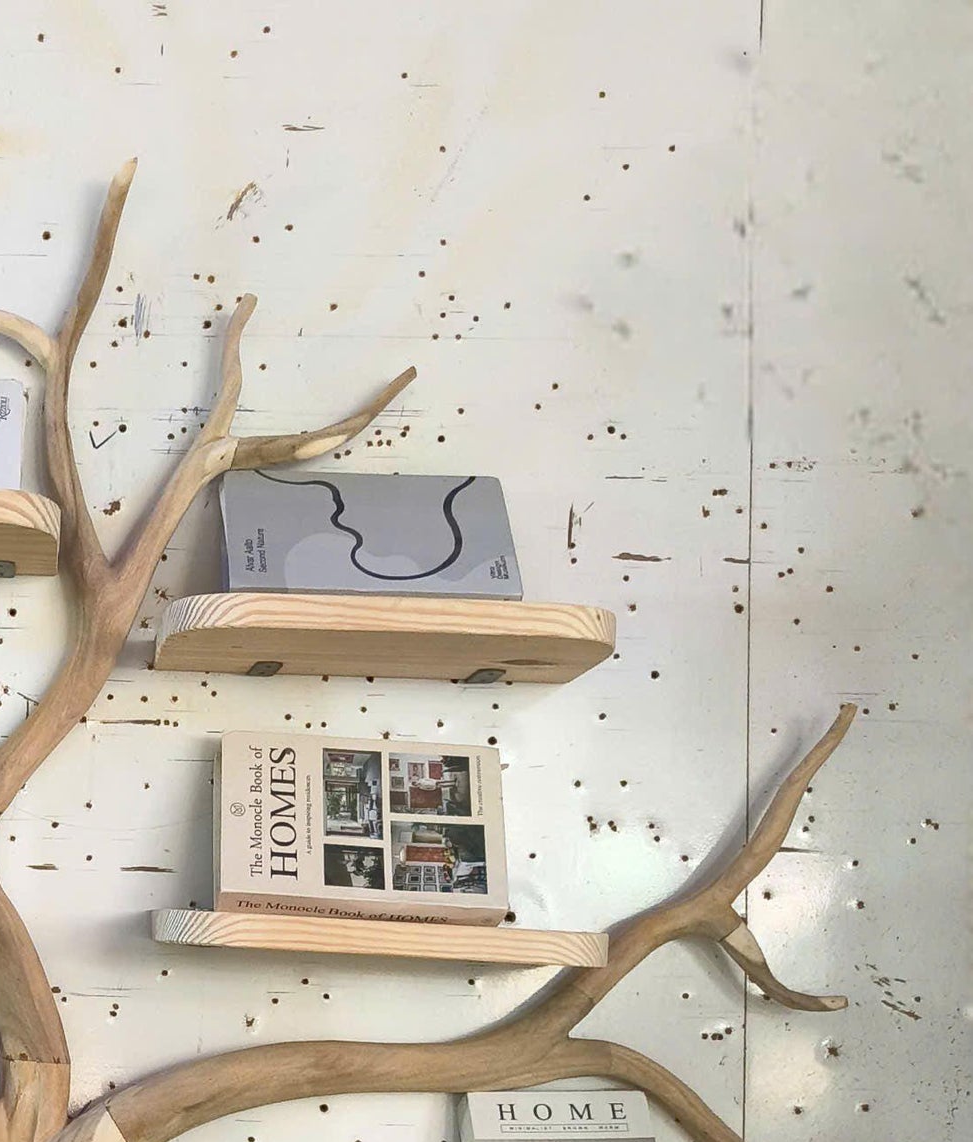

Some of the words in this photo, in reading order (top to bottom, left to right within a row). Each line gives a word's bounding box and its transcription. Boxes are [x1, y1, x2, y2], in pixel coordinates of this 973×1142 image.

[249, 745, 263, 759] of
[249, 763, 263, 793] Book
[248, 798, 263, 849] Monocle
[269, 747, 298, 881] HOMES
[249, 852, 263, 877] The
[236, 900, 262, 909] The
[265, 902, 325, 914] Monocle
[328, 907, 365, 918] Book
[388, 914, 449, 923] HOMES
[497, 1102, 627, 1121] HOME
